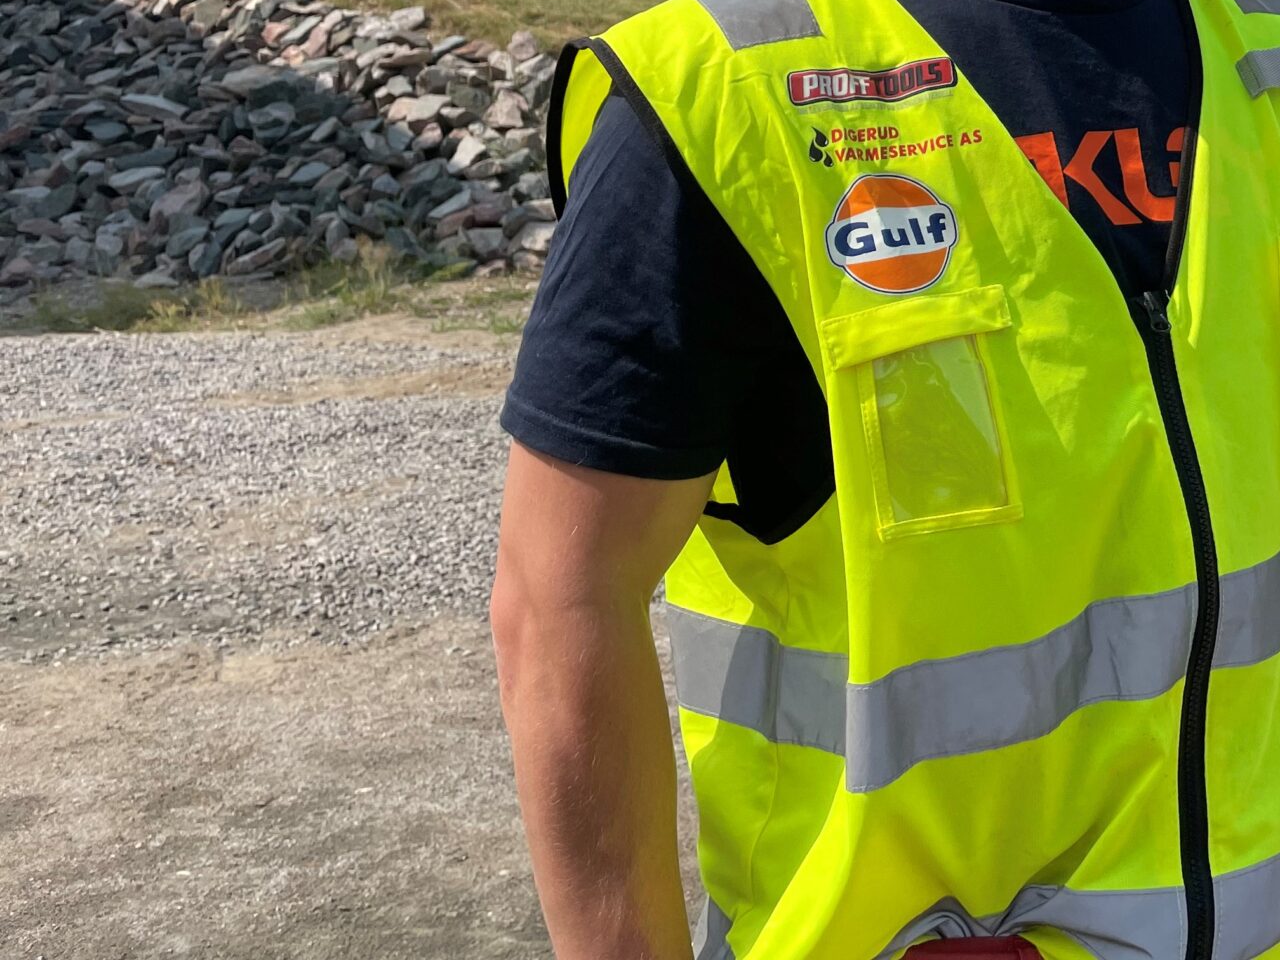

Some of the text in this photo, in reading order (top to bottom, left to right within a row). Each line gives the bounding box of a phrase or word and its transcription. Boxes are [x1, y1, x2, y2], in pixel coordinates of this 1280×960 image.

[831, 126, 899, 144] DIGERUD
[835, 129, 983, 163] VARMESERVICE AS
[834, 212, 947, 257] Gulf
